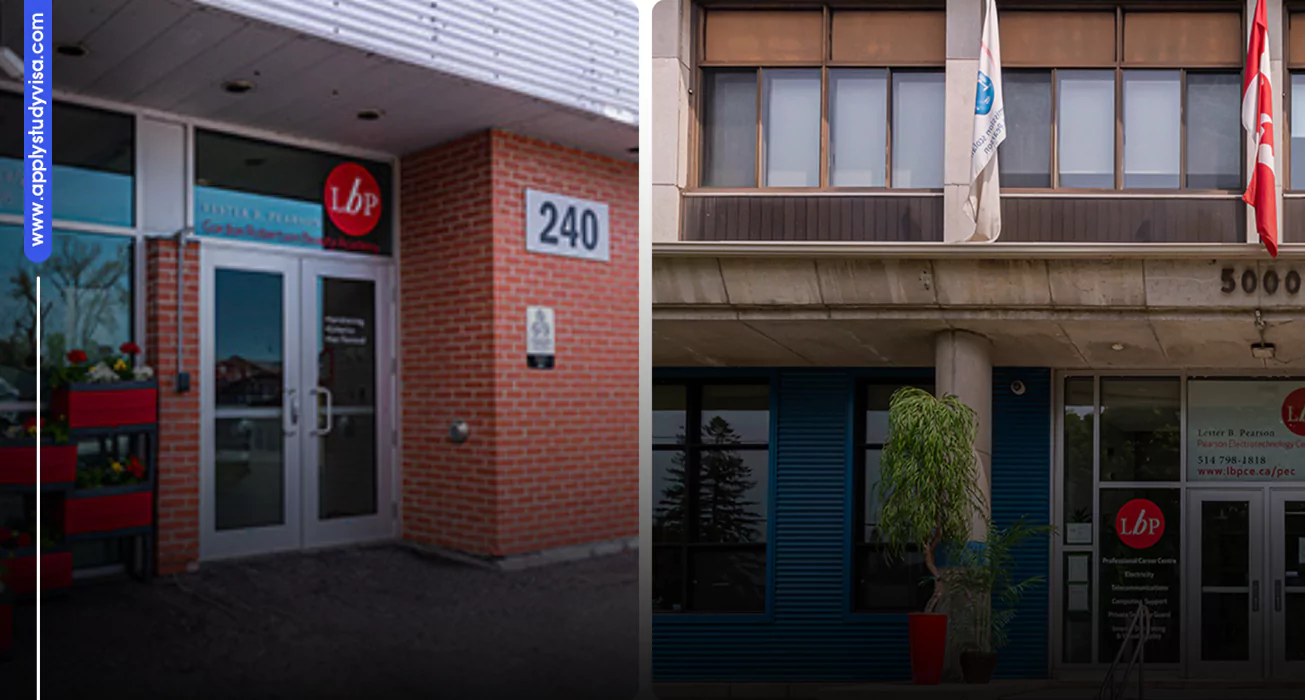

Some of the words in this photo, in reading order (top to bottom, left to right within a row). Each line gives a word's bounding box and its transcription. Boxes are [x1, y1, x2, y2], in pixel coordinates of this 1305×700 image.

[330, 177, 379, 217] LbP
[540, 200, 598, 250] 240
[1221, 268, 1301, 295] 5000
[1198, 429, 1226, 437] Lester
[1240, 429, 1275, 437] Pearson
[1197, 456, 1215, 464] 514
[1120, 508, 1161, 536] LbP
